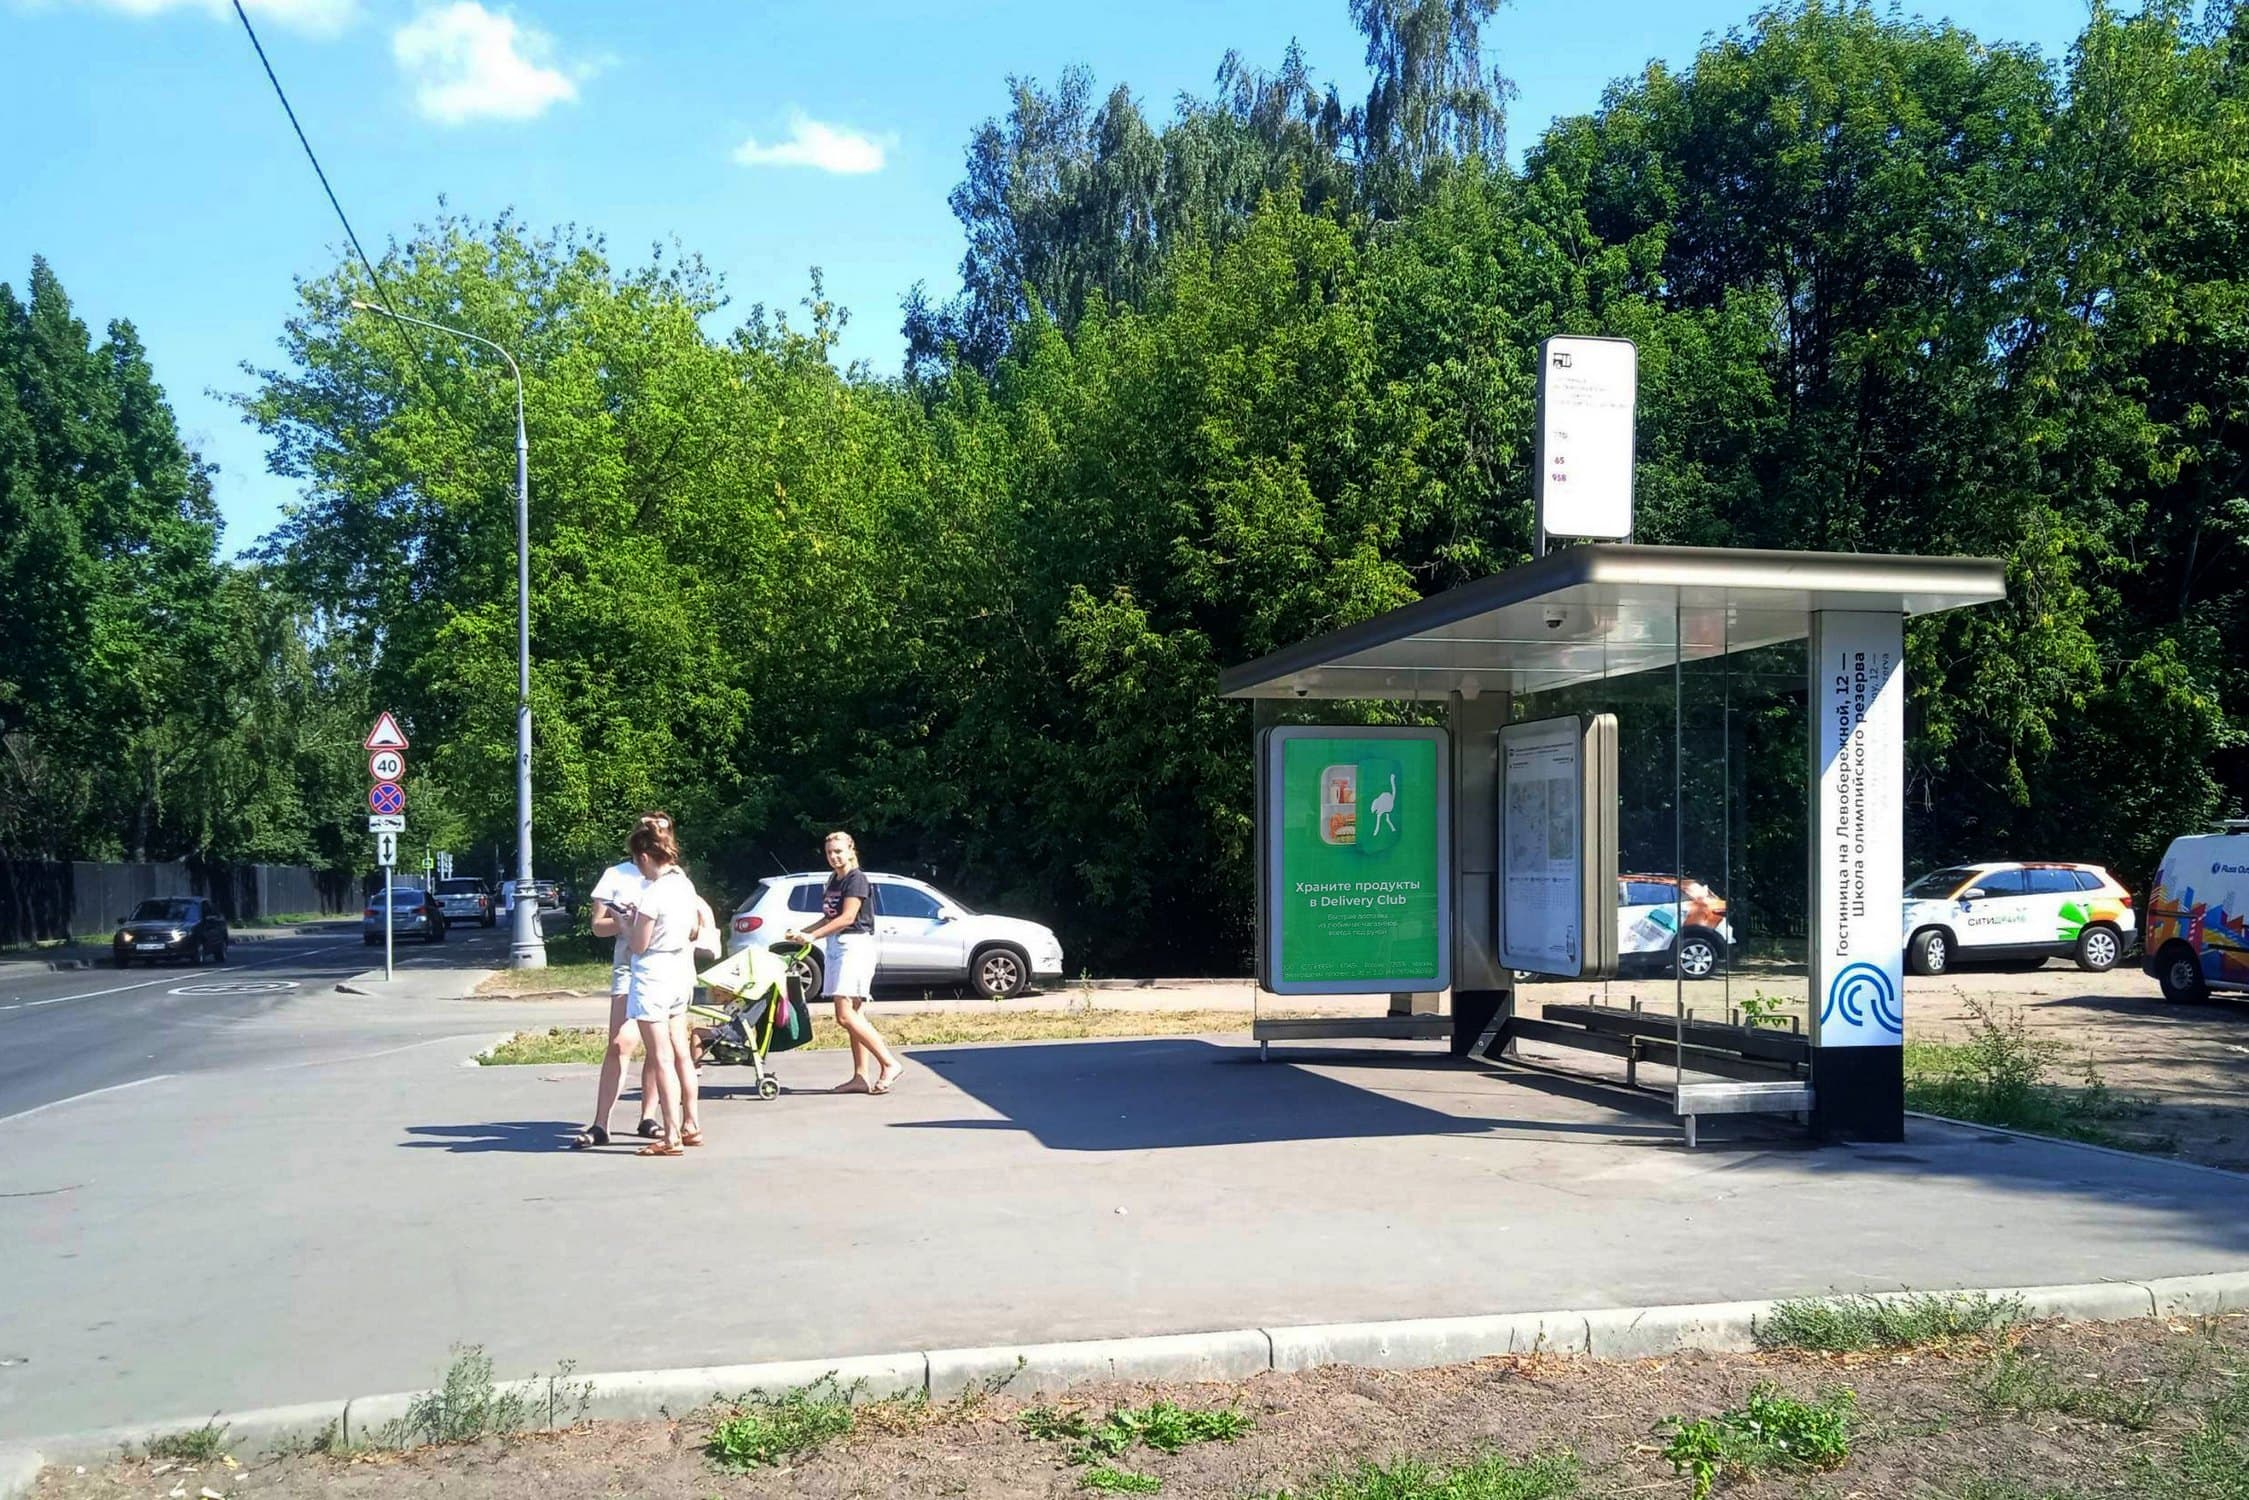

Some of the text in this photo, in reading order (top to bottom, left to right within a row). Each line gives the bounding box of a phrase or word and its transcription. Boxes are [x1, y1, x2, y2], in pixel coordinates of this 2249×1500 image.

[1836, 675, 1849, 695] 12
[377, 760, 397, 773] 40
[1836, 700, 1851, 838] Левобережной,
[1852, 652, 1868, 917] Школа олимпийского резерва
[1838, 844, 1849, 863] на
[1296, 880, 1420, 894] Храните продукты
[1310, 894, 1407, 908] в Delivery Club
[1836, 869, 1850, 957] Гостиница
